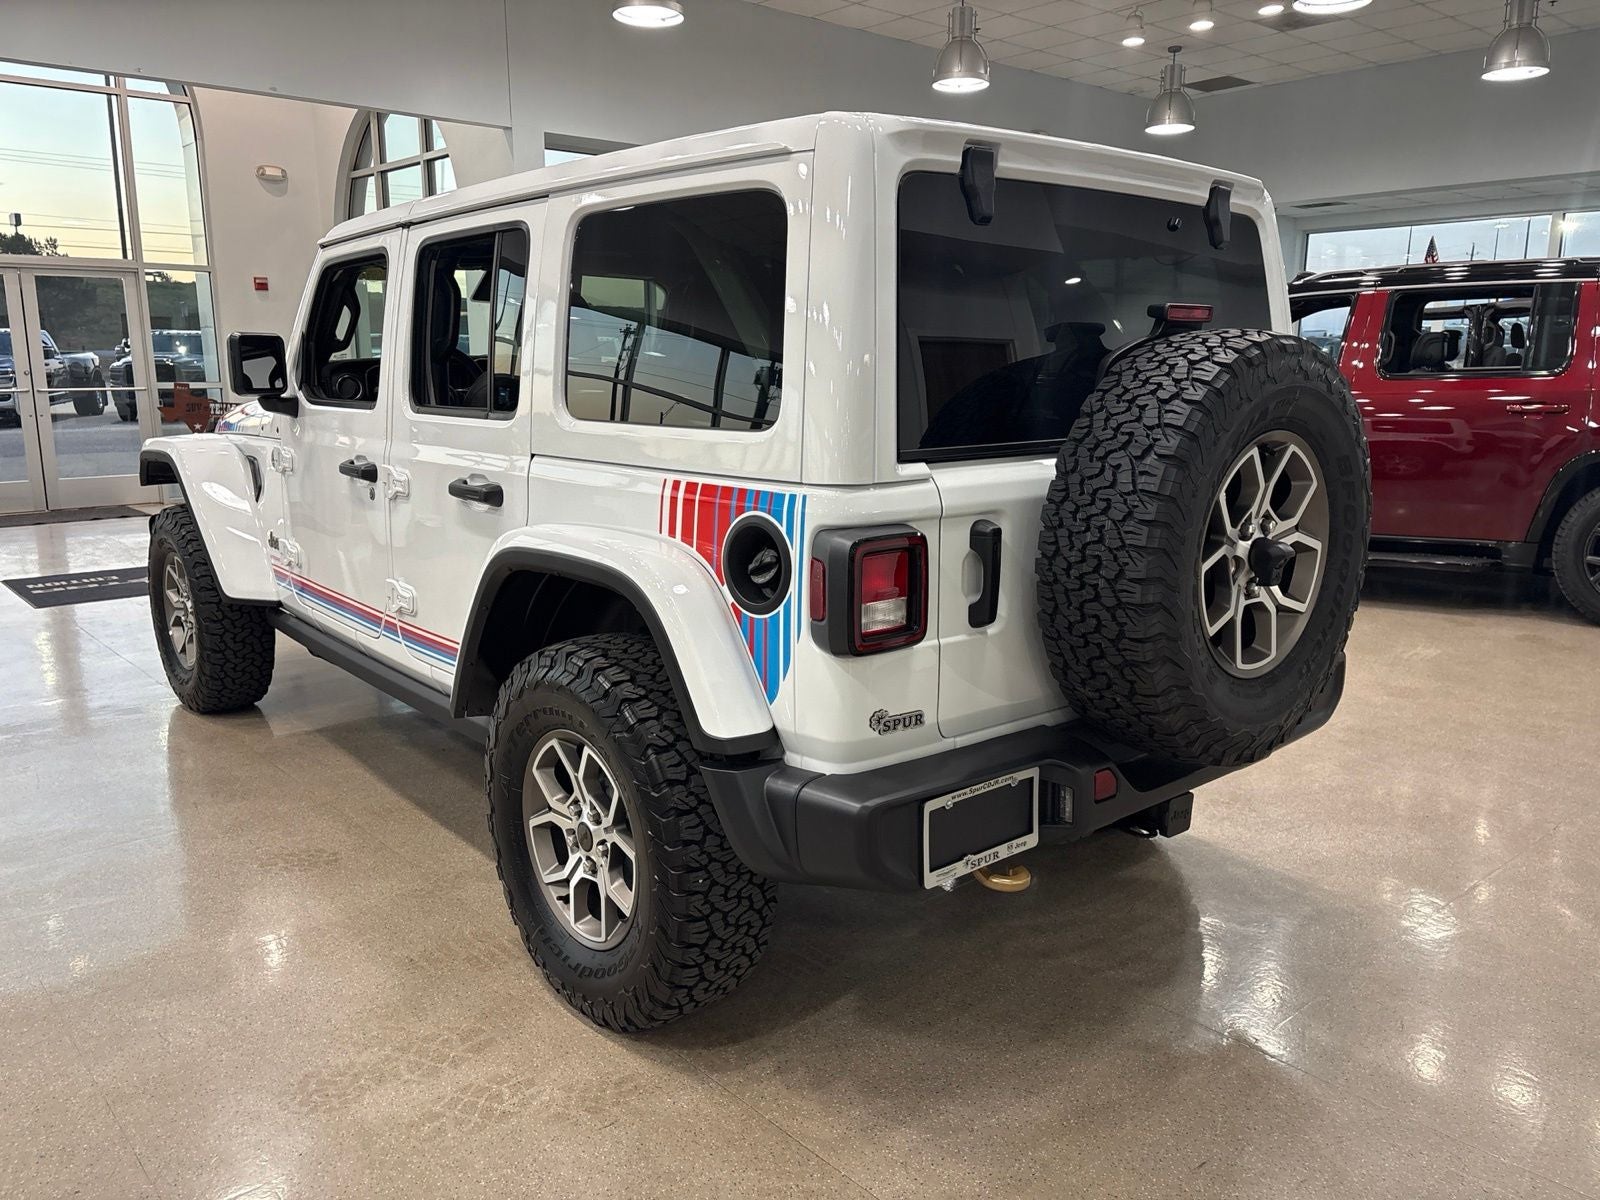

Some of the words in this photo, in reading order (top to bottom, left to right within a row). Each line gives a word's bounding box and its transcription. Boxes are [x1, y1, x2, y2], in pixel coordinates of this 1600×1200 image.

[882, 713, 923, 732] SPUR
[951, 775, 1014, 800] www.SpurCDJR.com
[1014, 841, 1028, 850] Jeep
[970, 851, 1001, 870] SPUR
